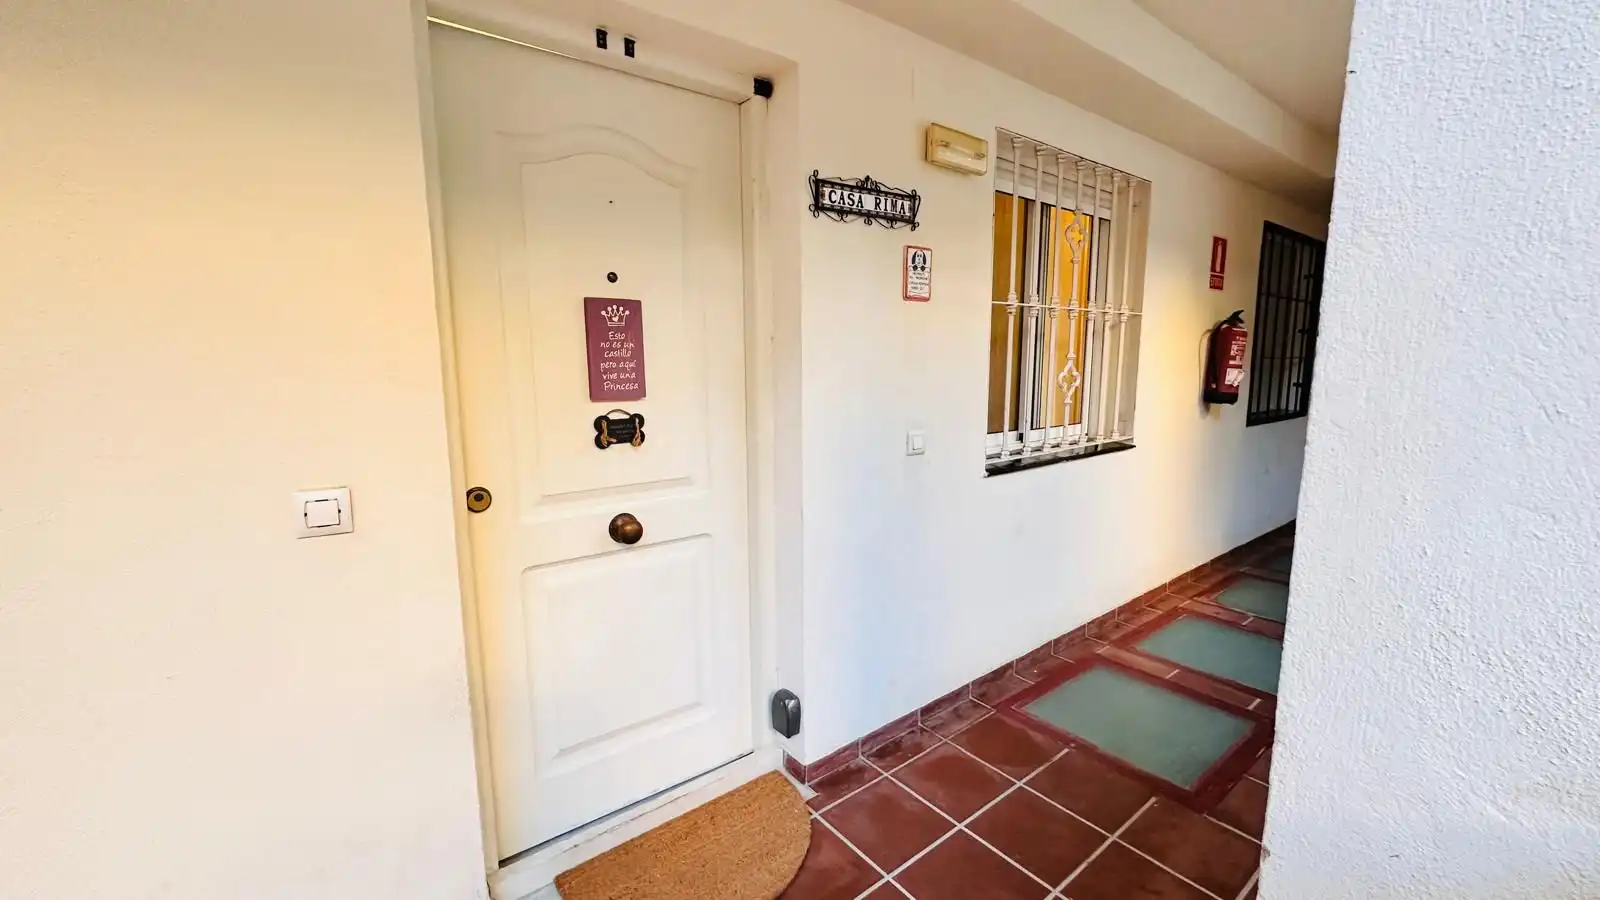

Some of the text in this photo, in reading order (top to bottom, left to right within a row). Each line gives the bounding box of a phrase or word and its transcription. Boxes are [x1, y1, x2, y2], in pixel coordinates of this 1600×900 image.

[828, 189, 907, 215] CASA RIMA
[608, 331, 626, 340] Esto
[604, 349, 632, 358] castillo
[600, 362, 617, 372] pero
[602, 372, 618, 380] vive
[603, 381, 639, 391] Princesa
